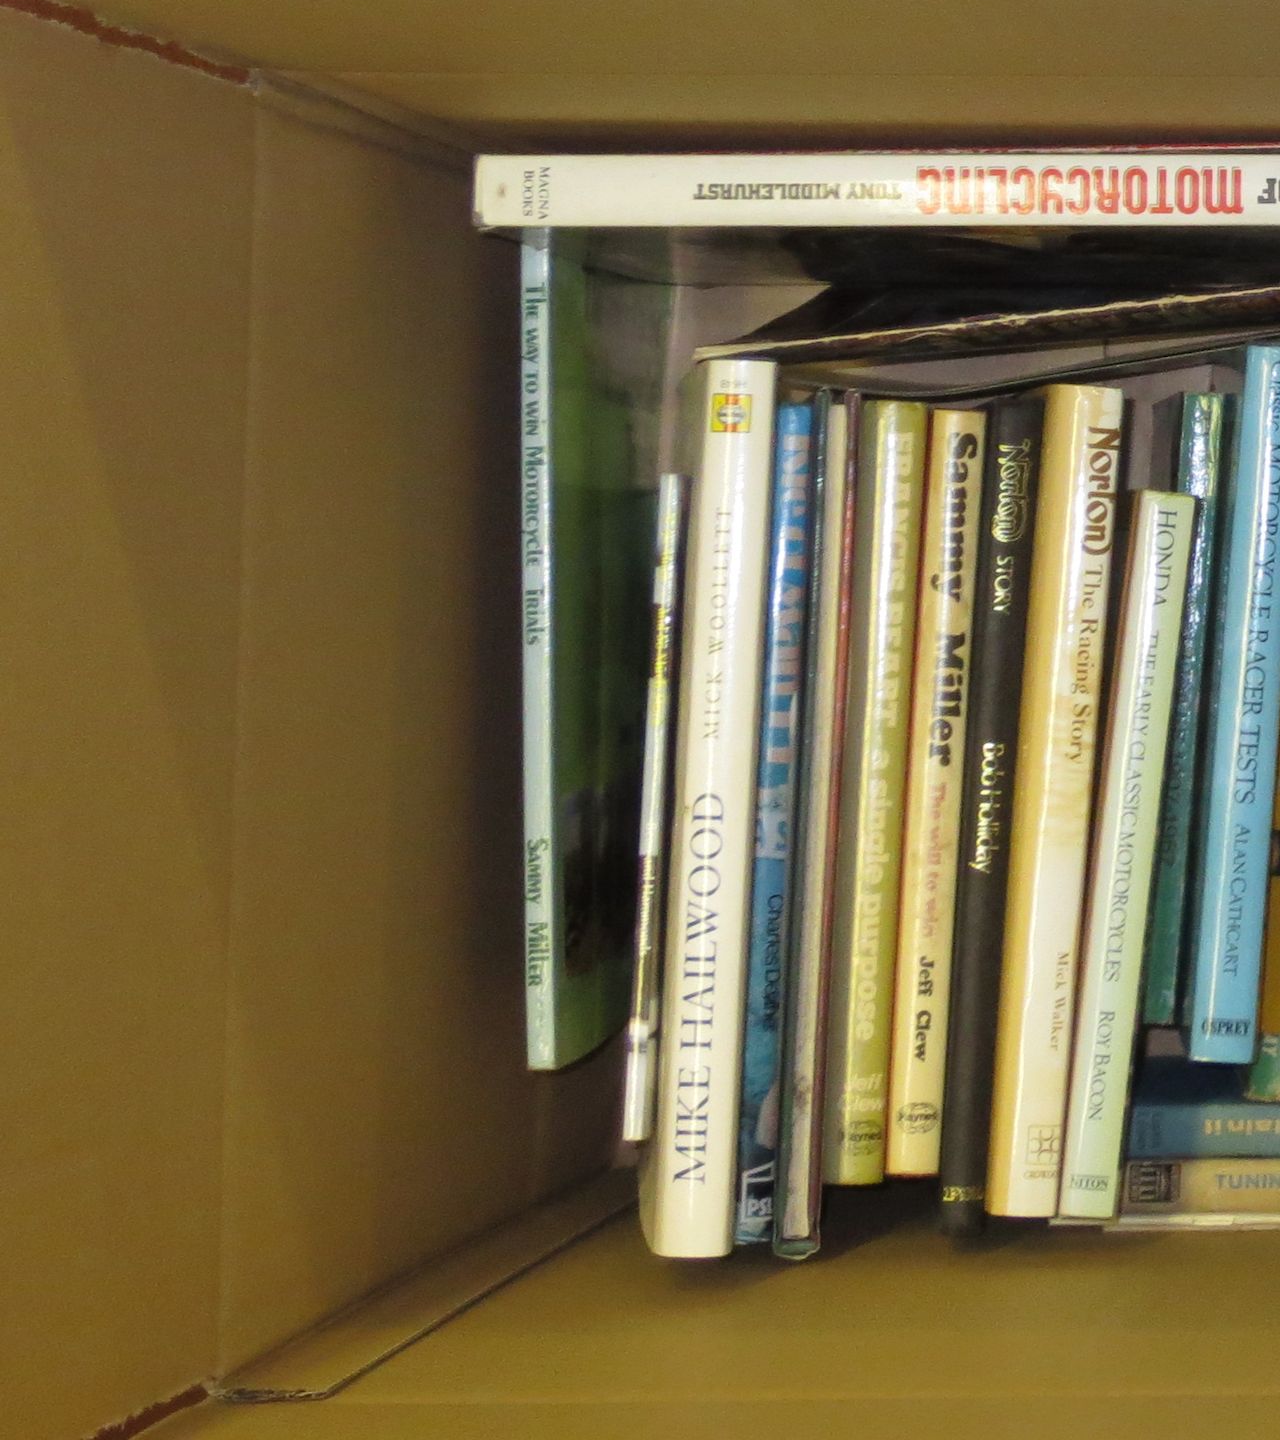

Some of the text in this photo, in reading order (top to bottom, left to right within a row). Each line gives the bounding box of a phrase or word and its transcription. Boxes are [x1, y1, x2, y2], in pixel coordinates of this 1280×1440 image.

[693, 182, 841, 201] MIDDLEHURST
[842, 182, 902, 200] TONY
[914, 164, 1244, 216] MOTORCYCLING
[702, 509, 733, 740] MICK WOOLLETT
[915, 432, 978, 1063] Sammy Miller Jeff Clew
[672, 791, 726, 1186] MIKE HAILWOOD
[1201, 1017, 1251, 1036] OSPREY
